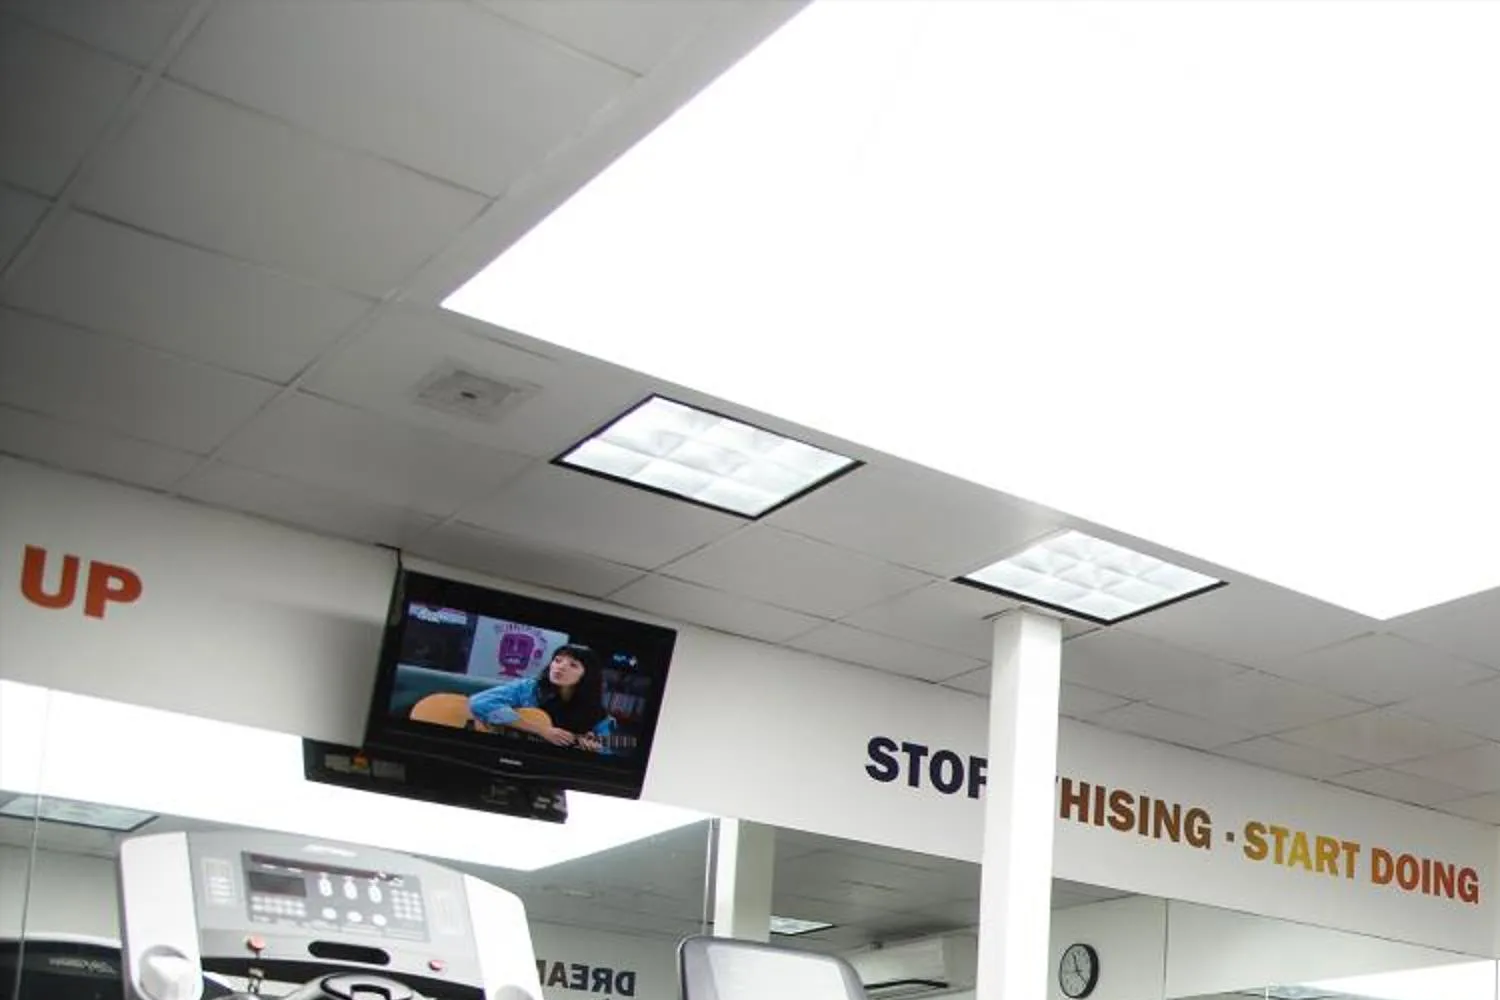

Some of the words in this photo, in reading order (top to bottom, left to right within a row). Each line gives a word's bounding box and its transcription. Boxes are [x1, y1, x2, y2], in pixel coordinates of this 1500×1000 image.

[21, 544, 143, 619] UP
[1054, 776, 1212, 849] HISING
[1243, 820, 1361, 880] START
[1371, 847, 1480, 904] DOING
